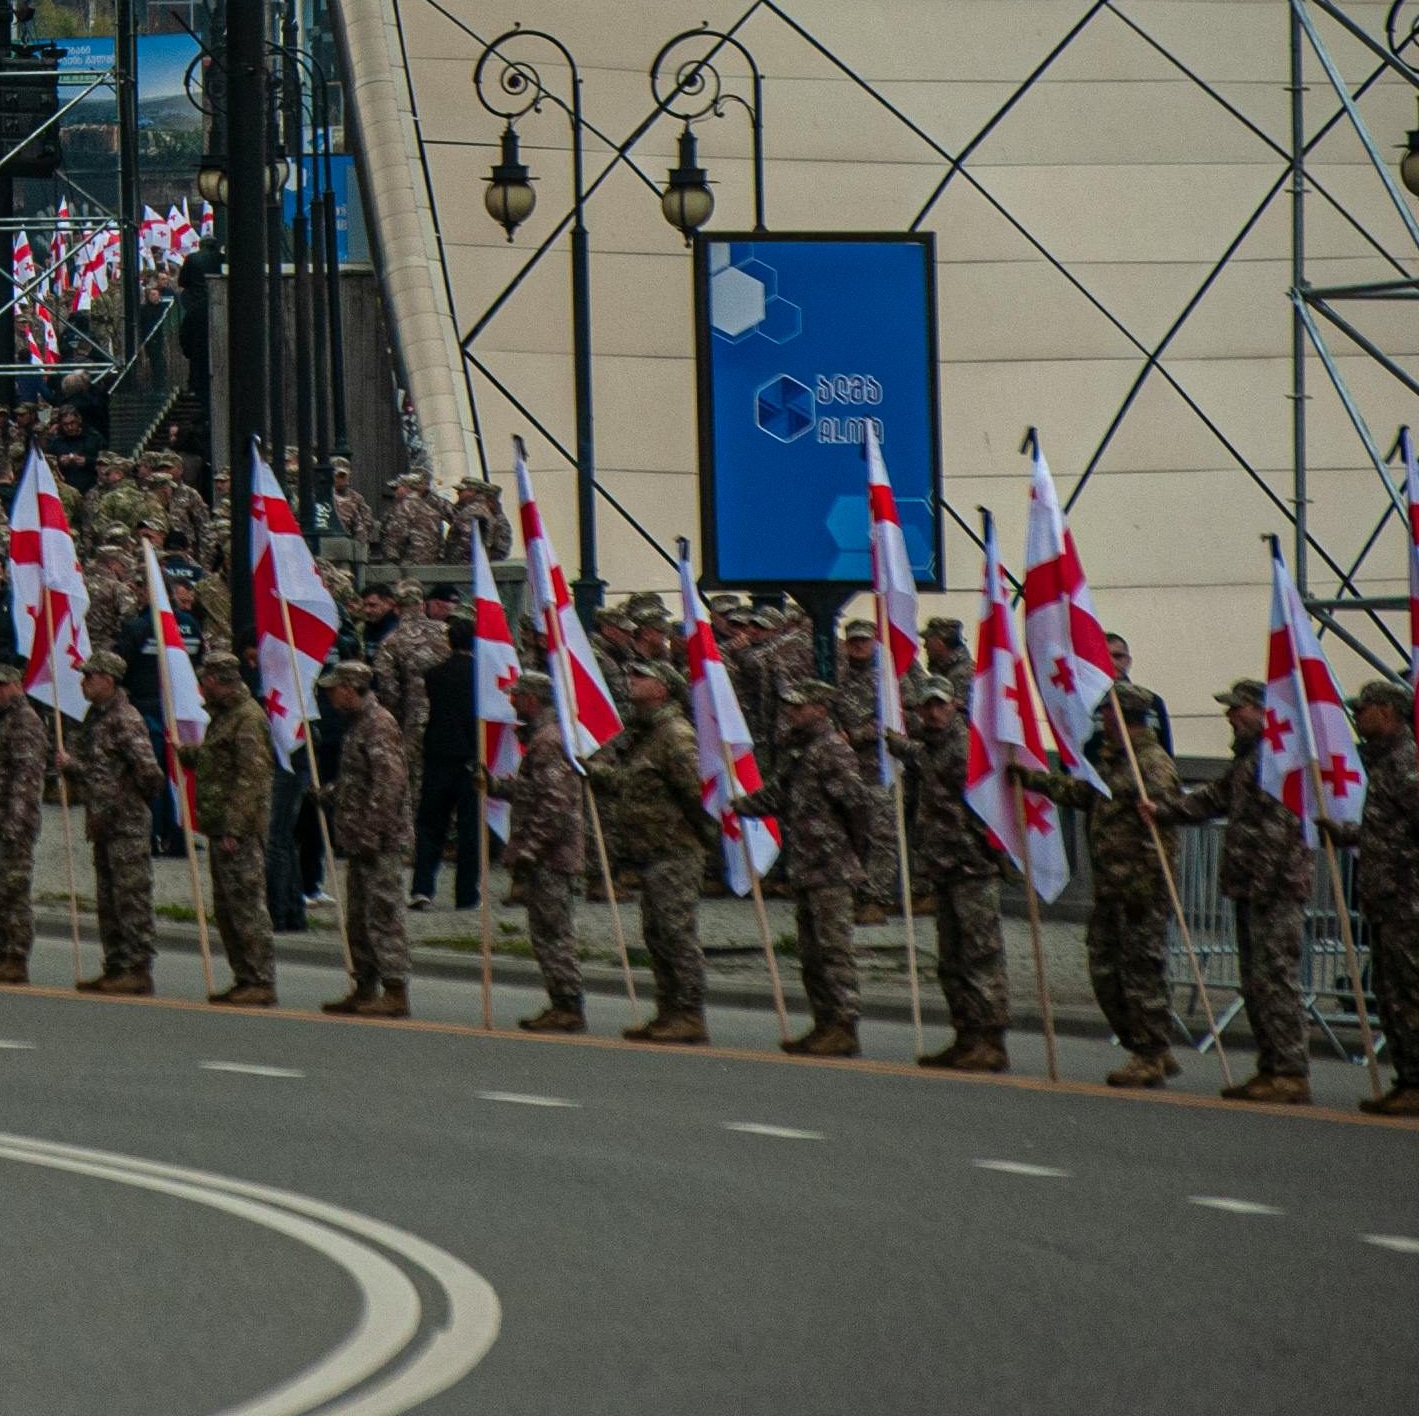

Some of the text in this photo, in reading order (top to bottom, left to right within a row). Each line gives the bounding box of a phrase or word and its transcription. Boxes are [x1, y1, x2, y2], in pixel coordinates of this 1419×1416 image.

[816, 374, 883, 405] აღმა
[818, 417, 885, 444] ALMA
[163, 568, 194, 578] LICE
